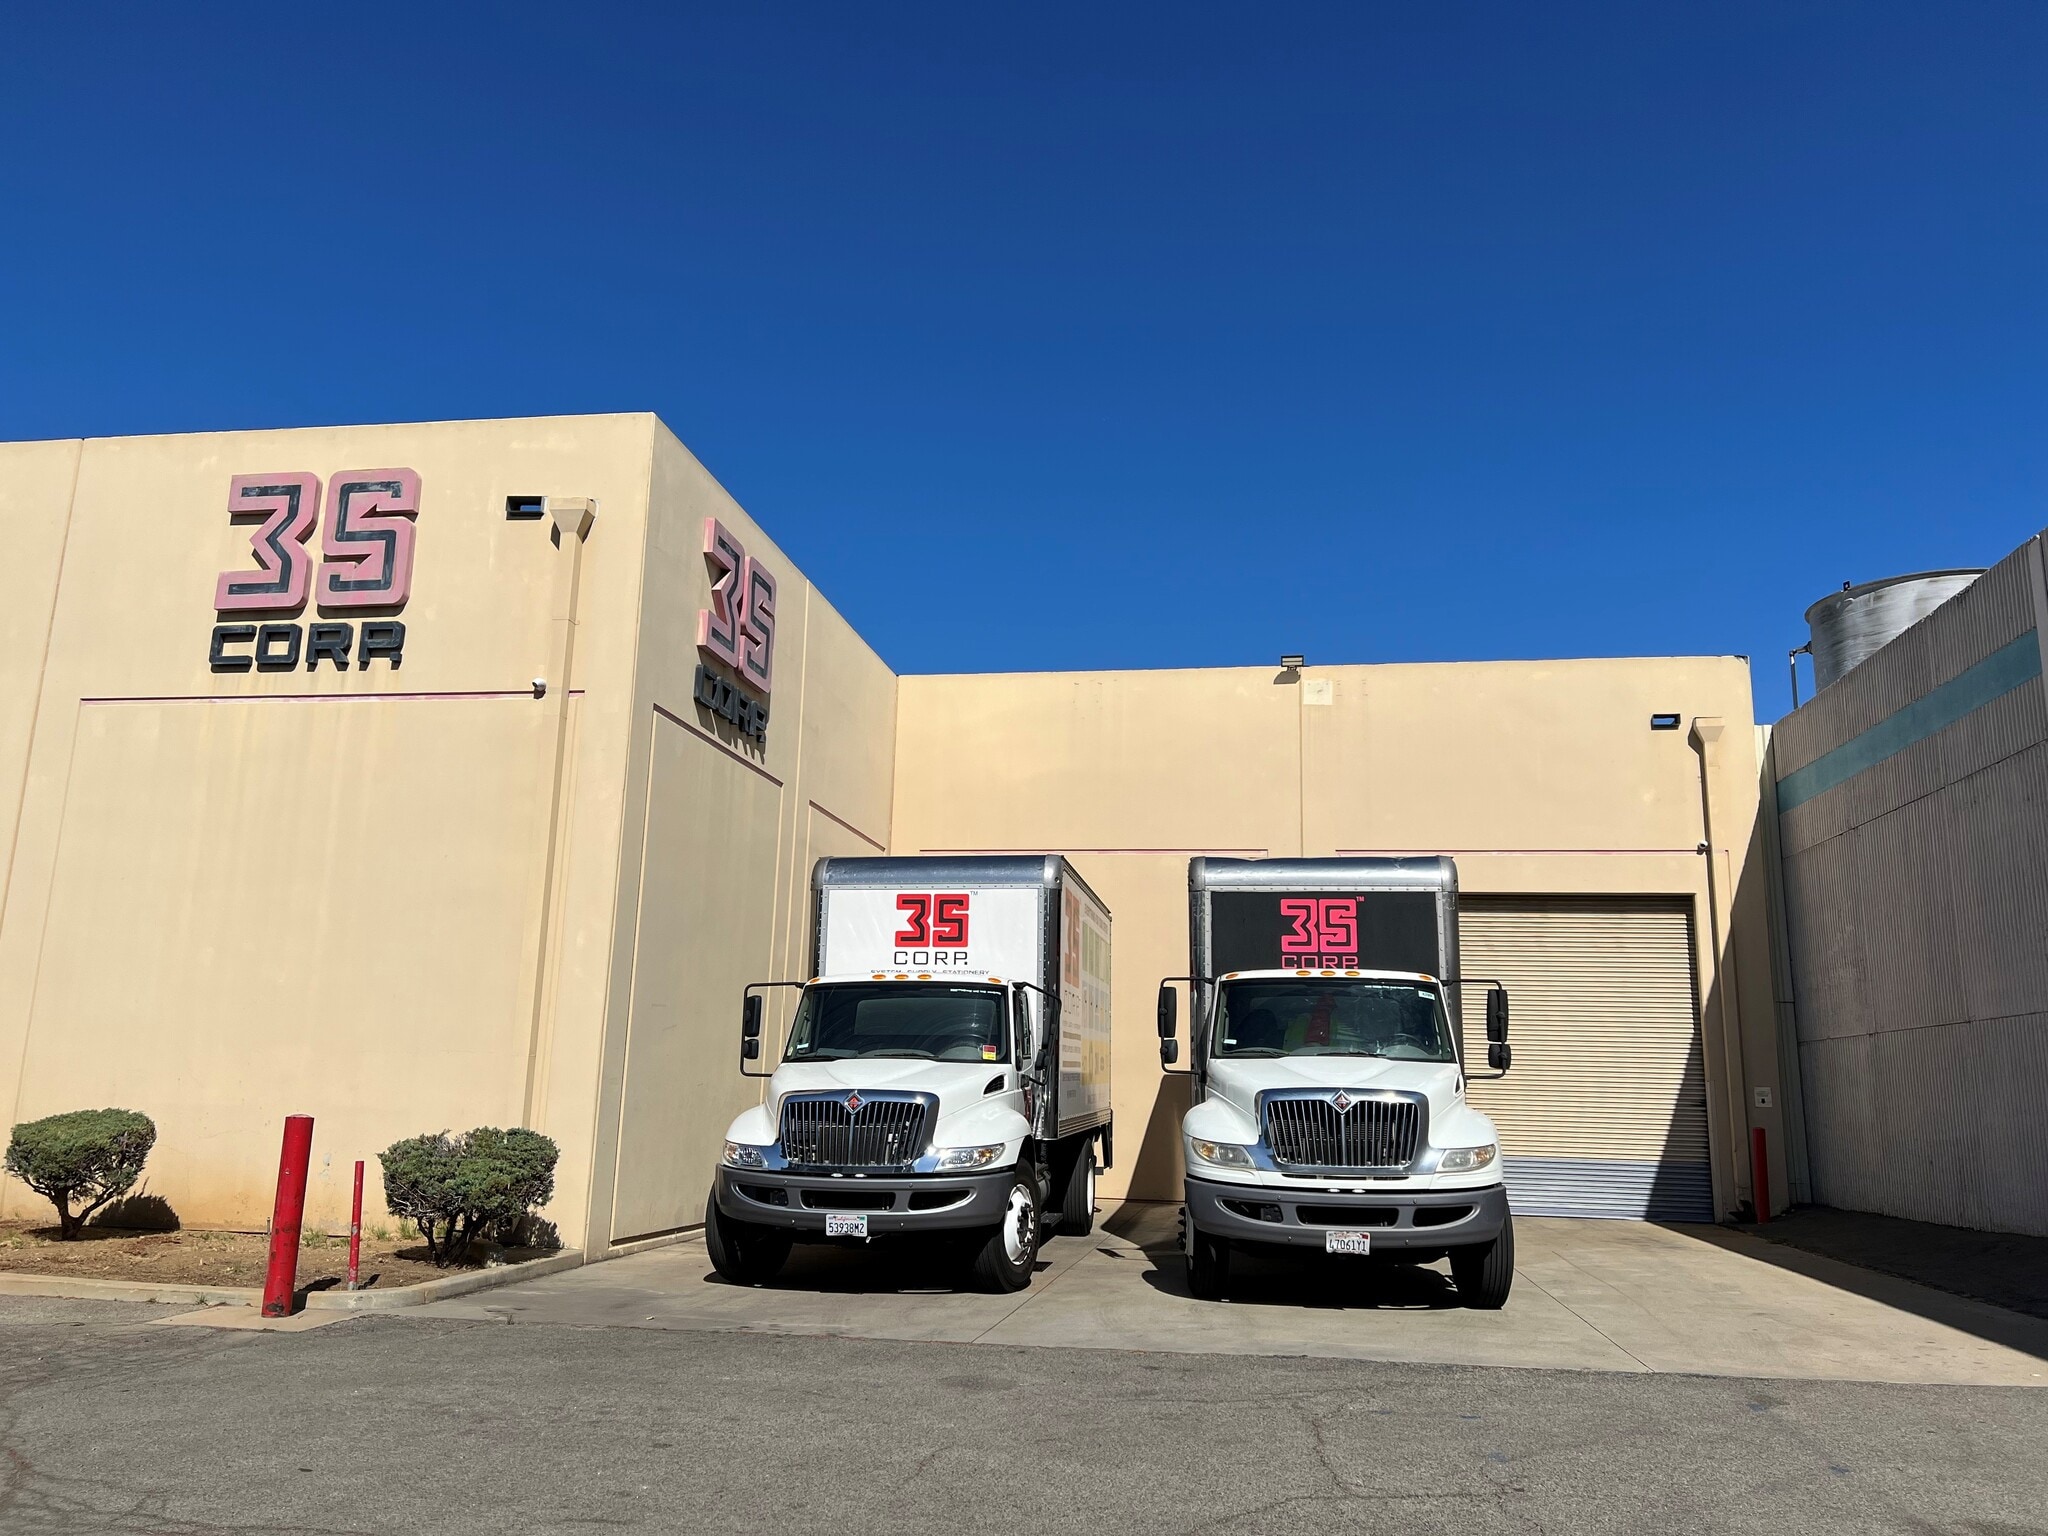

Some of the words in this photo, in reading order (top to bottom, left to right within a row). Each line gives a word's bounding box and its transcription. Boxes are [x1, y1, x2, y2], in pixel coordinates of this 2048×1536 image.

[214, 467, 422, 611] 3S
[696, 517, 777, 693] 3S
[209, 621, 406, 667] CORP.
[895, 894, 969, 947] 3S
[1280, 898, 1358, 953] 3S
[894, 951, 968, 965] CORP.
[828, 1222, 865, 1234] 53938M2
